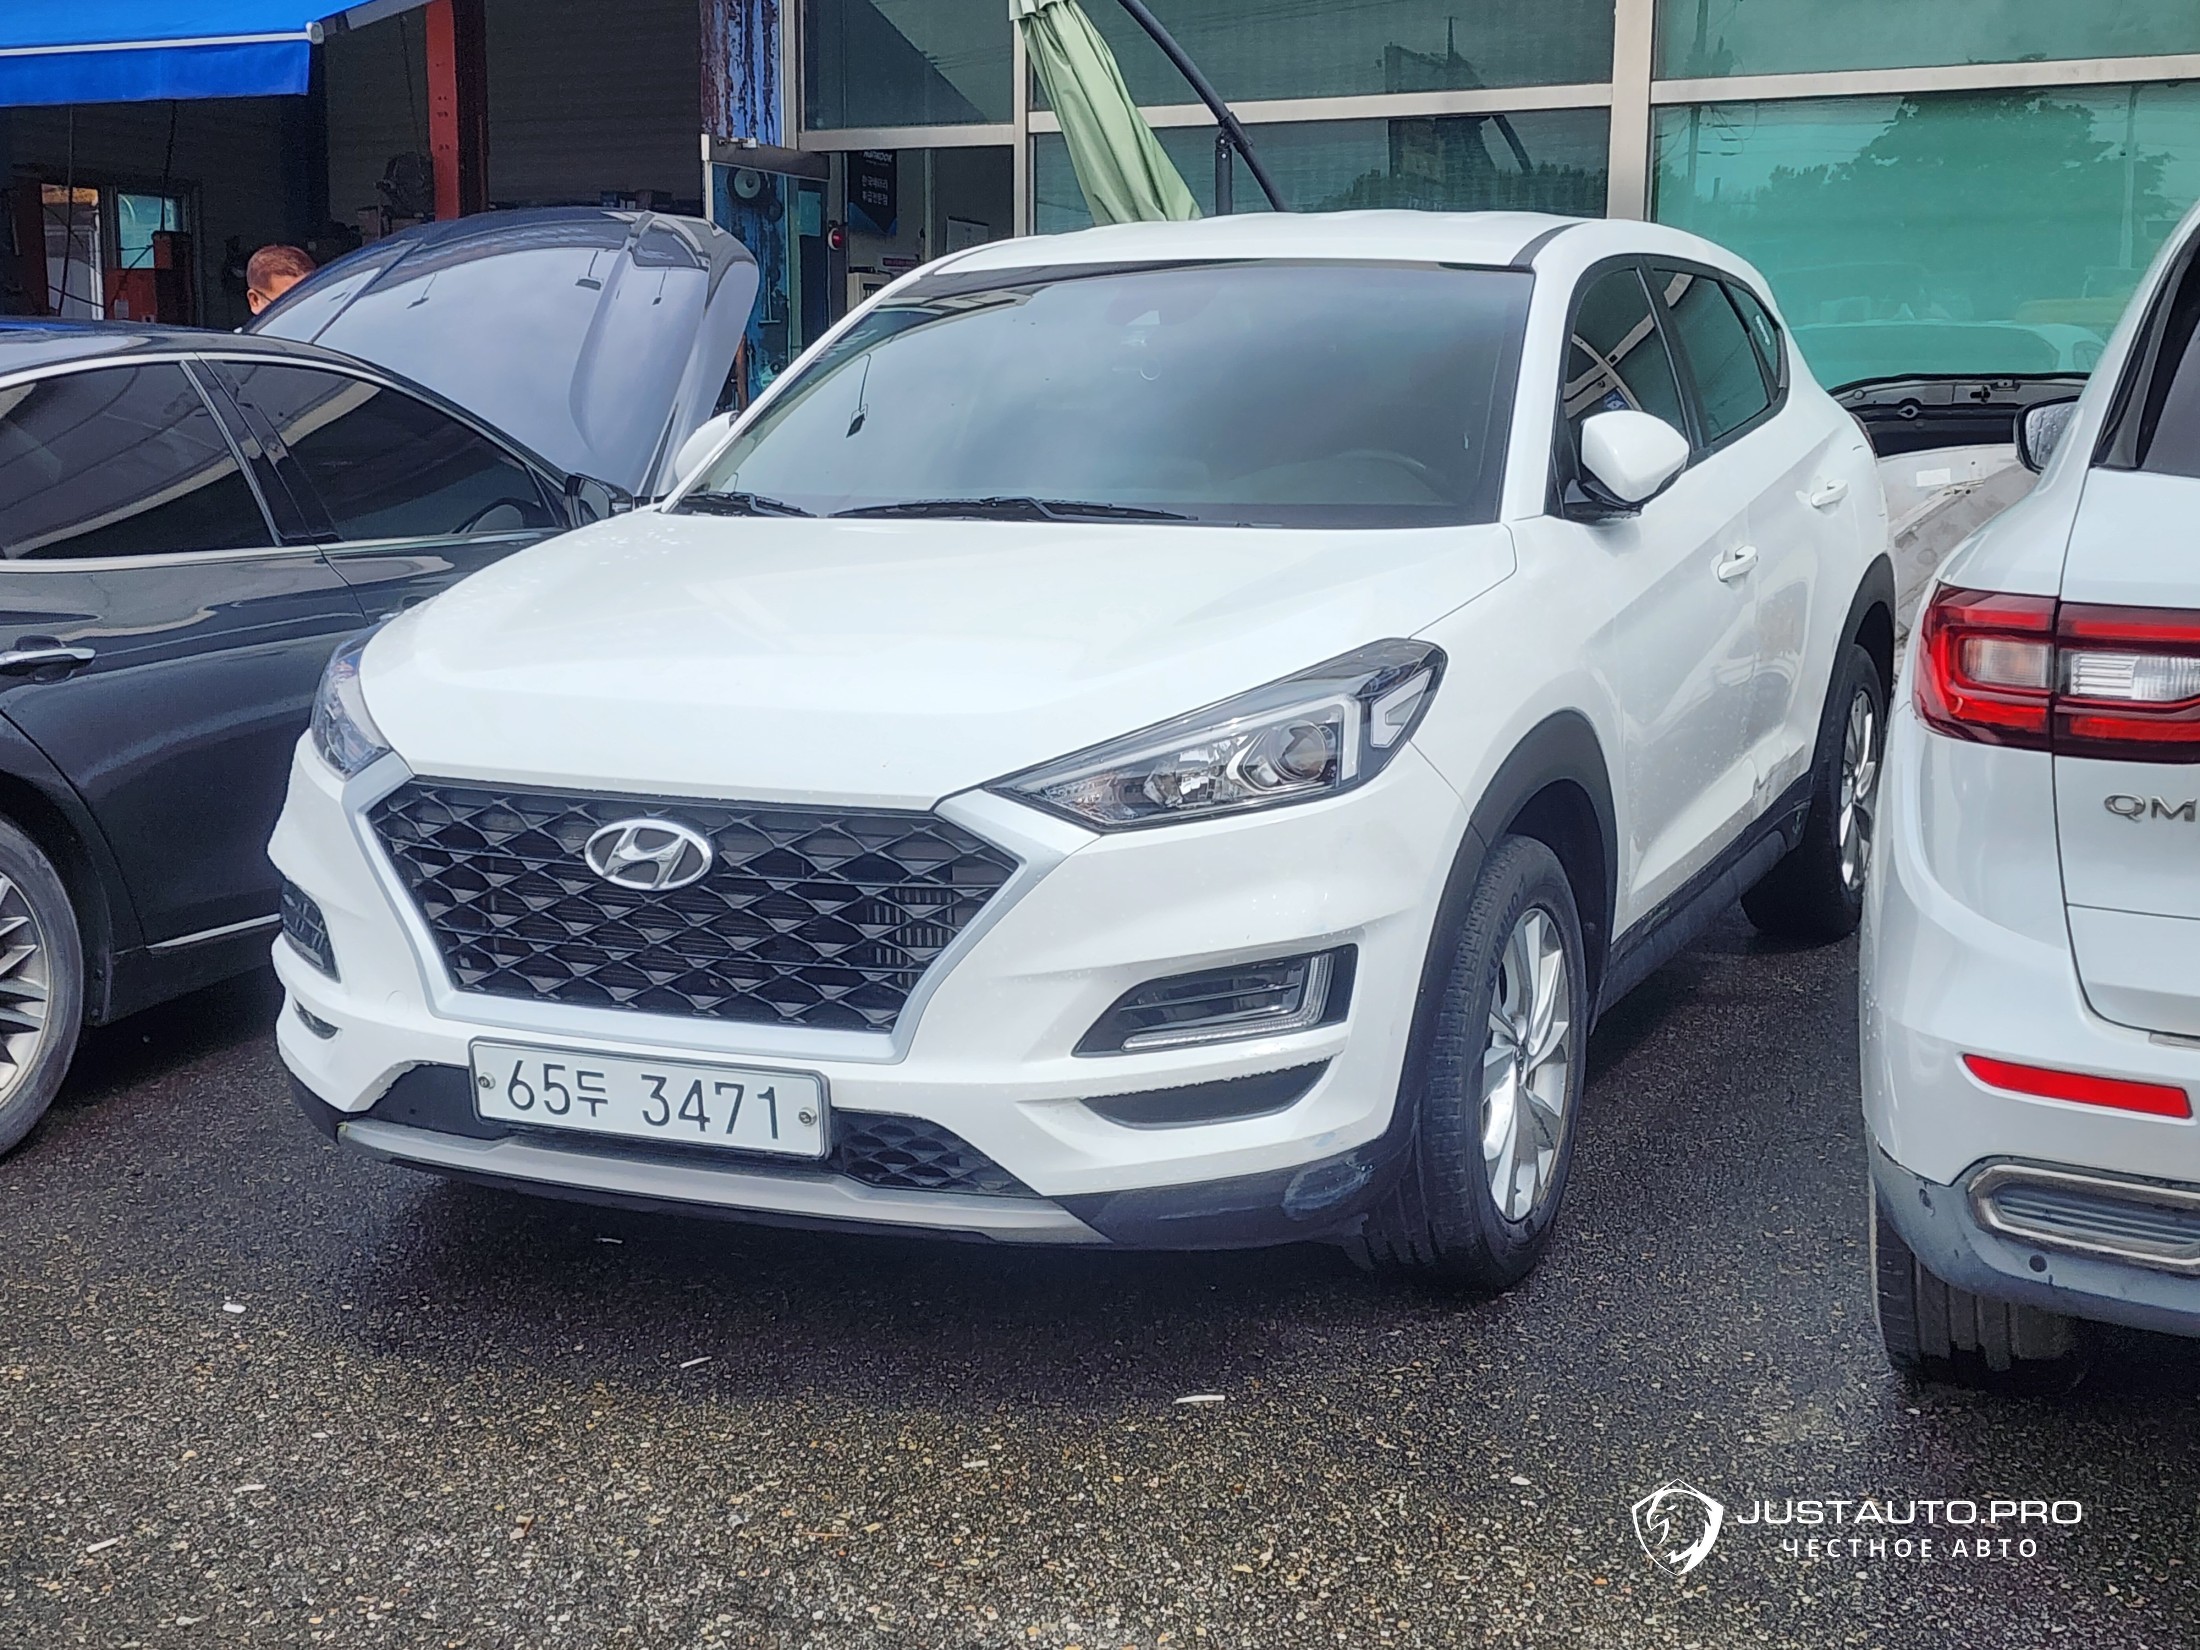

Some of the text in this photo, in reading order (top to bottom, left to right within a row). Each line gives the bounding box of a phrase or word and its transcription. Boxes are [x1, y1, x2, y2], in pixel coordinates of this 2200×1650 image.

[2104, 793, 2197, 822] QM
[506, 1059, 780, 1140] 65두 3471
